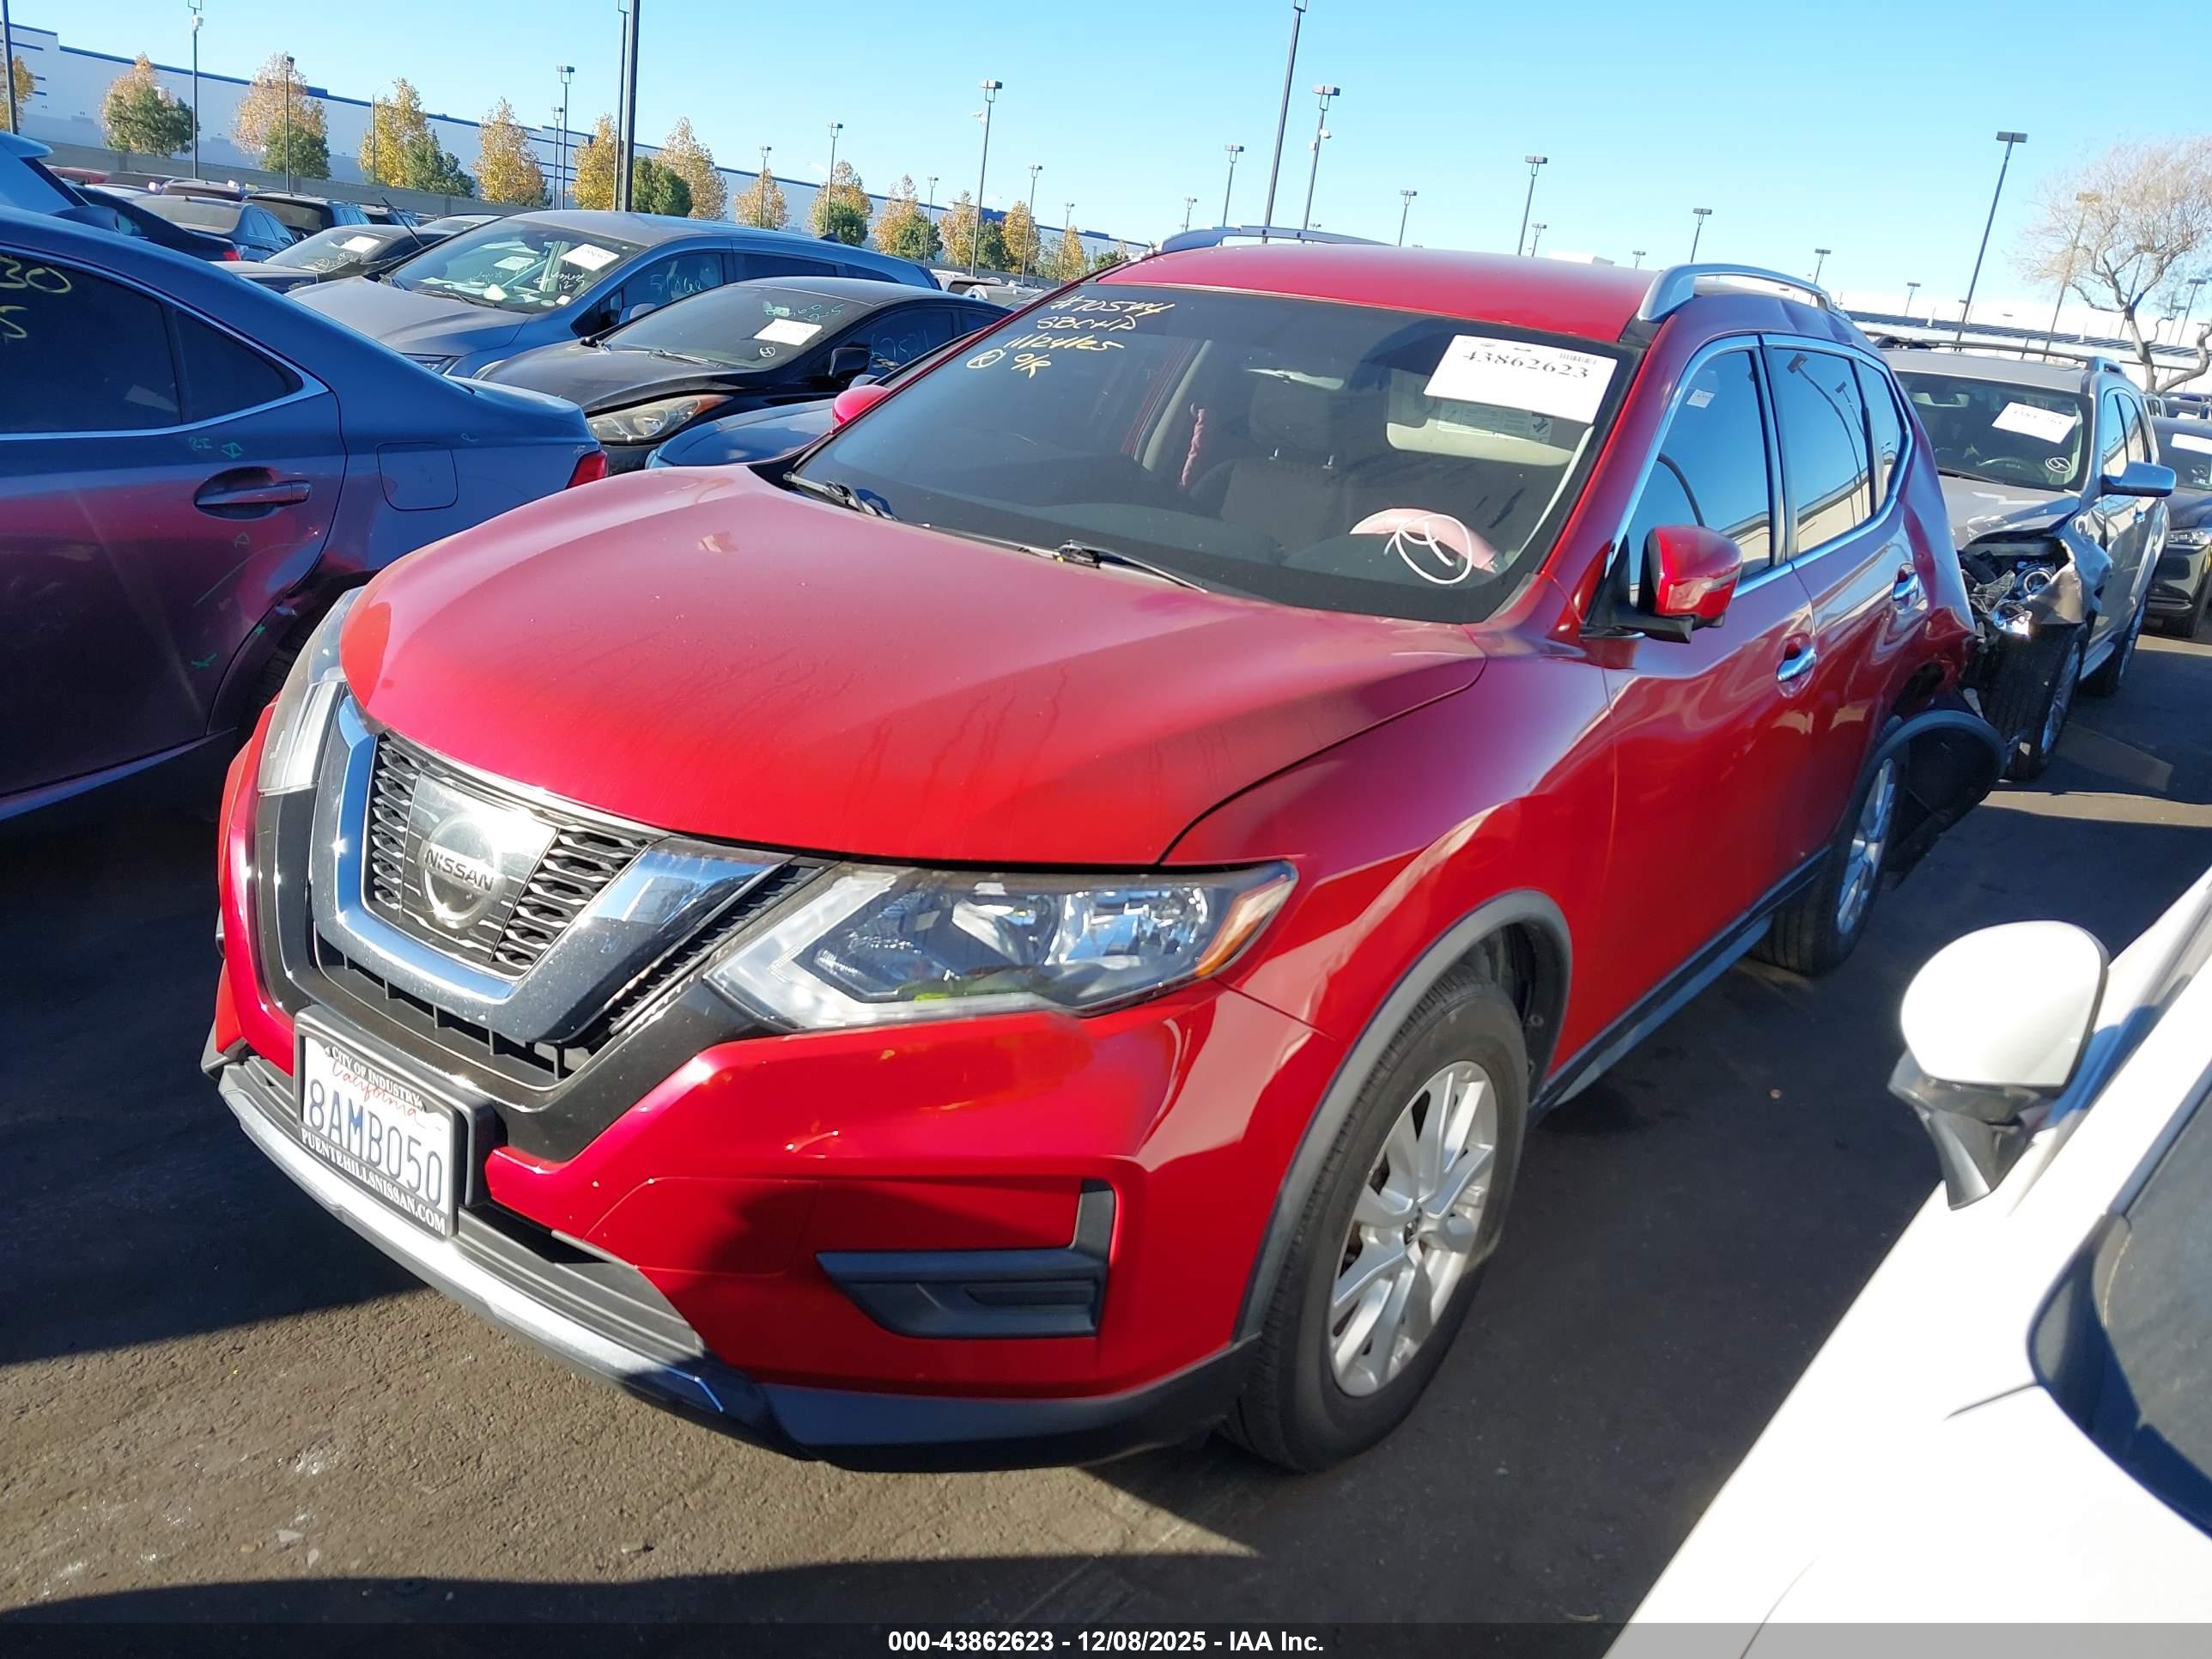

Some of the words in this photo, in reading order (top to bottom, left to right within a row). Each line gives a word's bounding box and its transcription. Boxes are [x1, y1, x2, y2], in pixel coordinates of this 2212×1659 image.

[1462, 349, 1589, 379] 43862623
[425, 848, 495, 891] NISSAN
[332, 1046, 353, 1069] CITY
[354, 1061, 367, 1079] OF
[368, 1070, 421, 1106] INDUSTRY
[309, 1079, 443, 1206] 8AMB050
[301, 1127, 447, 1236] PUENTEHILLSNISSAN.COM
